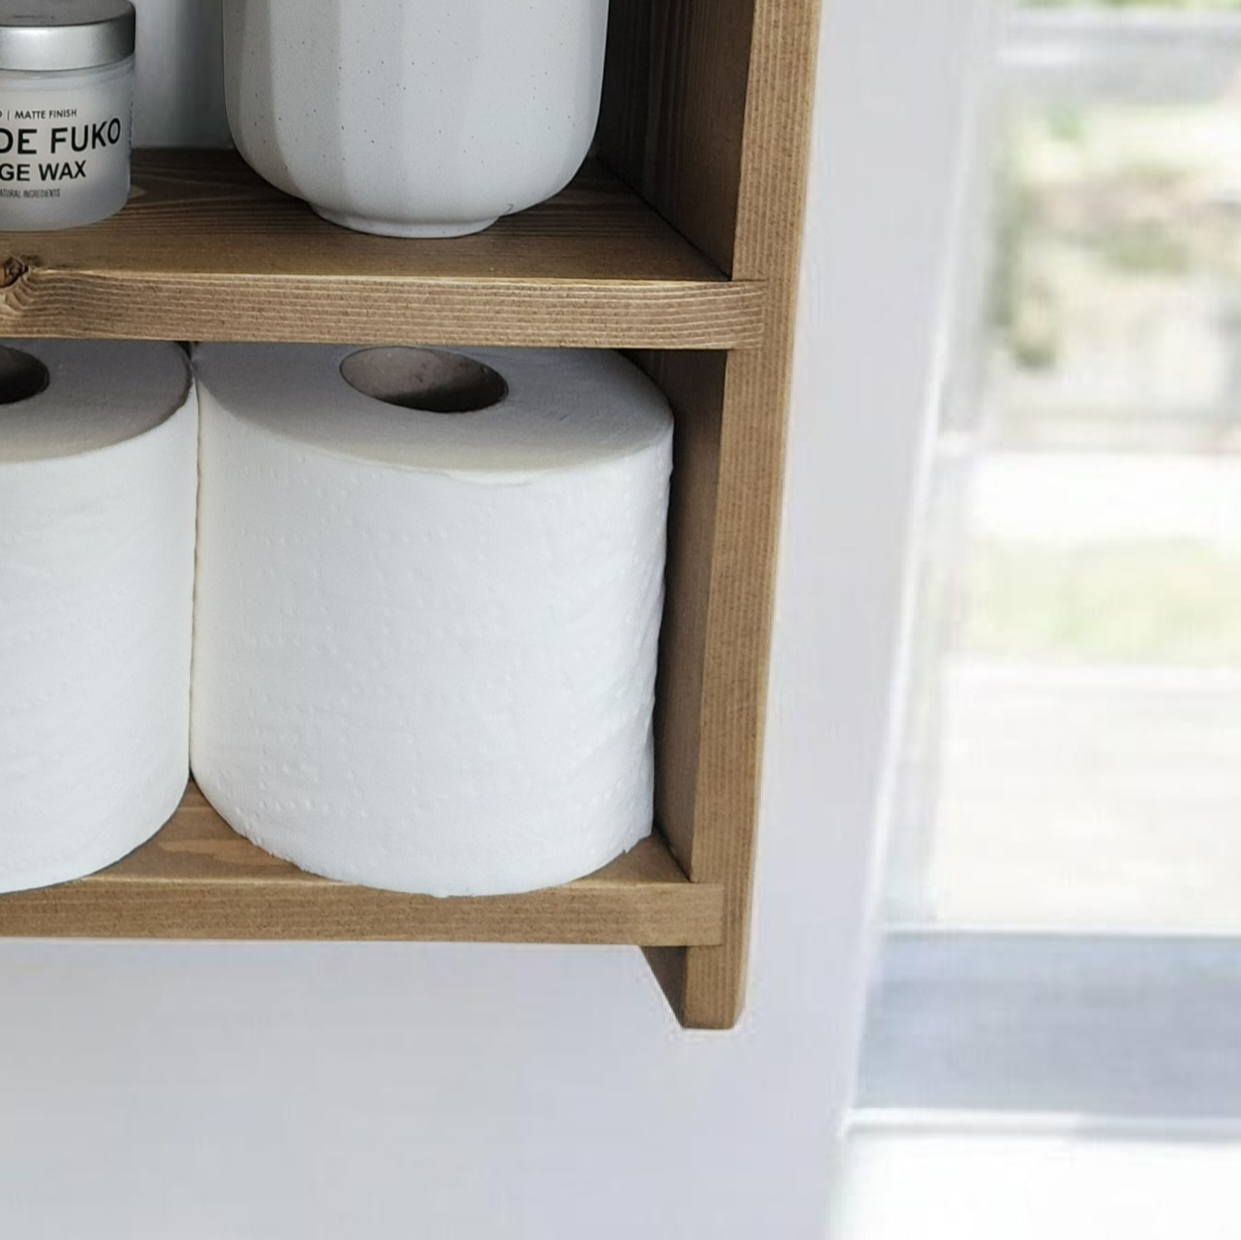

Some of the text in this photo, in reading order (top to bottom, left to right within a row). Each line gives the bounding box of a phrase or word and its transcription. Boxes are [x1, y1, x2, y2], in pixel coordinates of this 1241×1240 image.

[14, 109, 46, 120] MATTE
[49, 108, 78, 118] FINISH
[50, 118, 121, 154] FUKO
[38, 160, 87, 182] WAX
